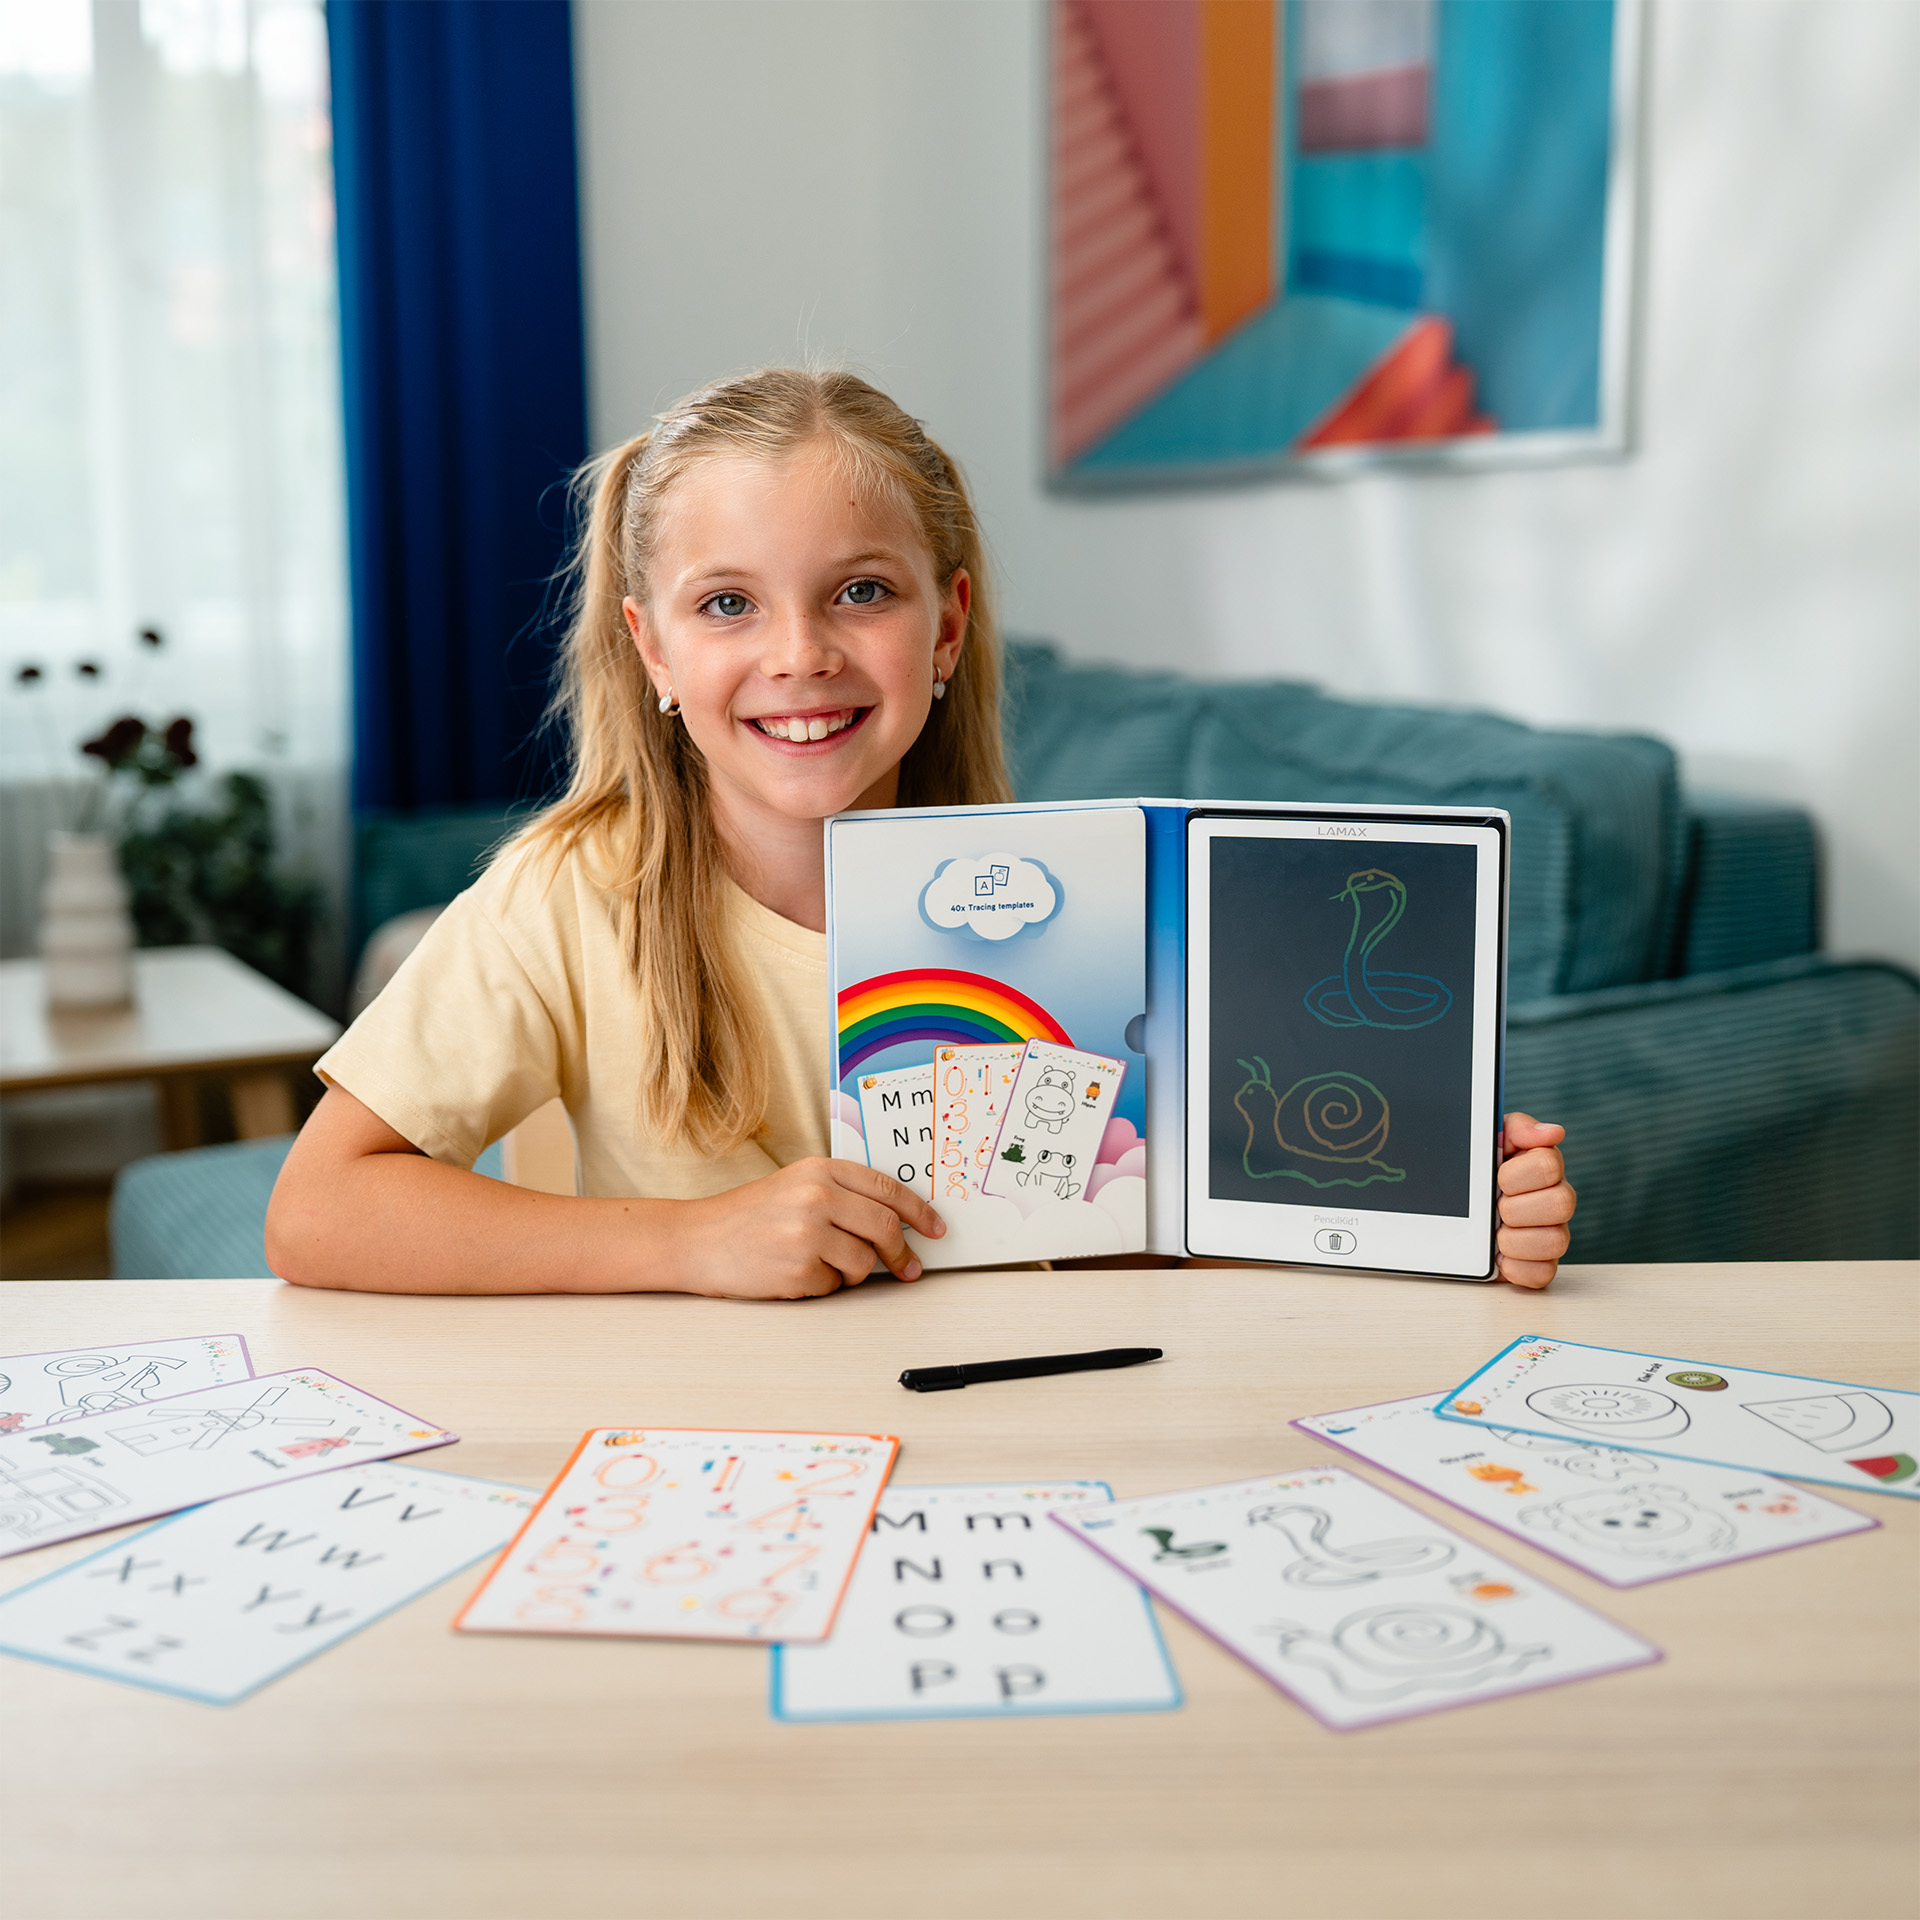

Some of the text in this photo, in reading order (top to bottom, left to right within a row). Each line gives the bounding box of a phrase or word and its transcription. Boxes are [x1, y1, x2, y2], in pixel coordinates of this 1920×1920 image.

[1318, 826, 1367, 837] LAMAX
[980, 881, 989, 891] A
[950, 901, 1035, 912] 40x Tracing templates
[882, 1089, 934, 1112] M m
[893, 1126, 933, 1147] N n
[898, 1163, 915, 1182] O
[340, 1487, 396, 1511] V
[871, 1510, 1032, 1534] M m
[235, 1522, 319, 1553] W
[894, 1557, 1025, 1582] N n
[910, 1658, 957, 1696] P
